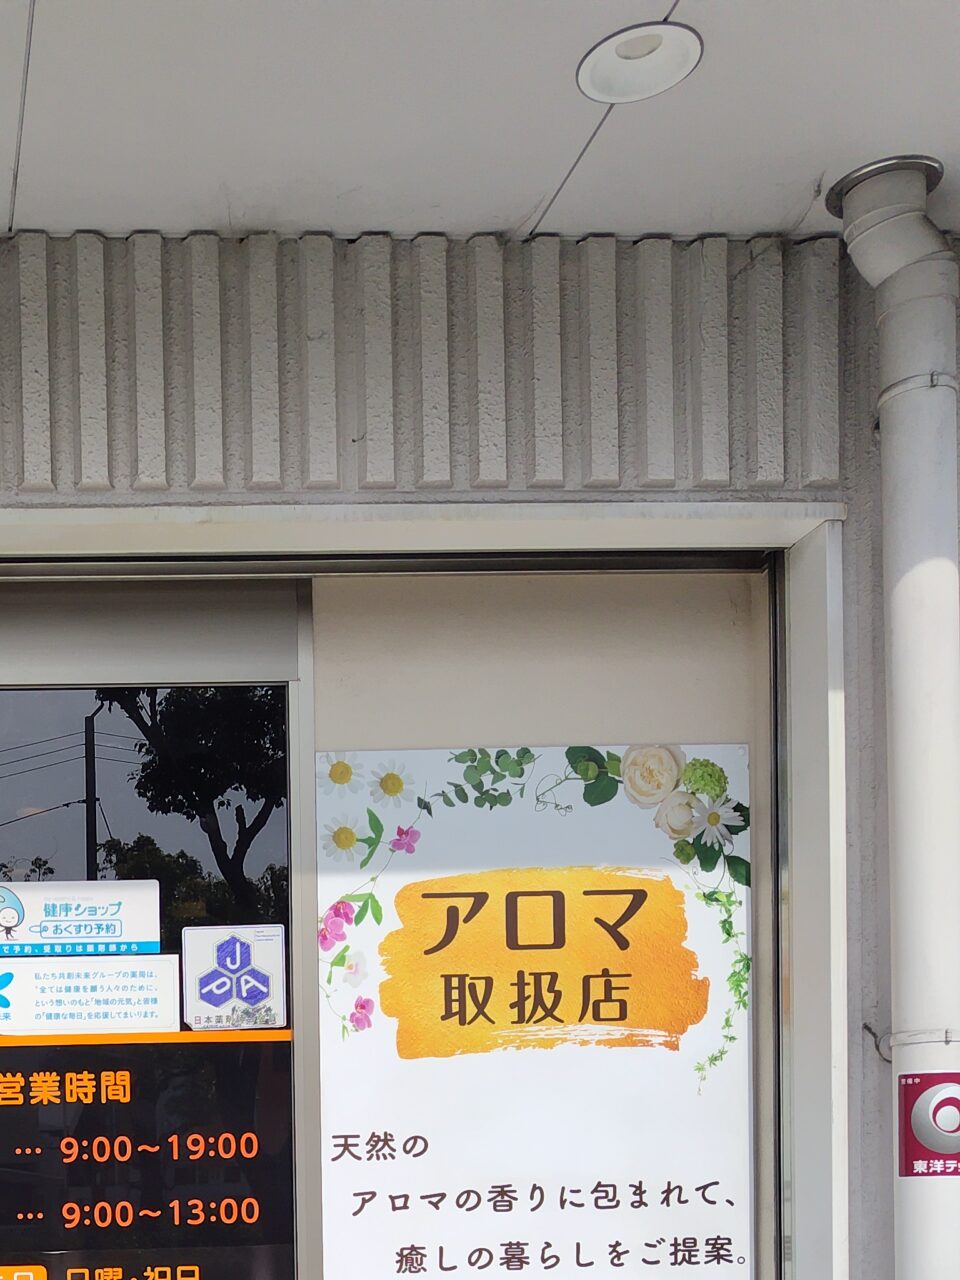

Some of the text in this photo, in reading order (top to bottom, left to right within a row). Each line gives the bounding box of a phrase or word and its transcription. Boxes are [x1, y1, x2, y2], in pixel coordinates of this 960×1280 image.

[43, 901, 123, 918] 健康ショップ
[420, 888, 649, 957] アロマ
[52, 923, 117, 935] おくすり予約
[439, 967, 633, 1027] 取扱店
[330, 1131, 430, 1162] 天然の
[912, 1159, 960, 1174] 東洋テ
[351, 1179, 737, 1218] アロマの香りに包まれて、
[395, 1235, 747, 1275] 癒しの暮らしをご提案。
